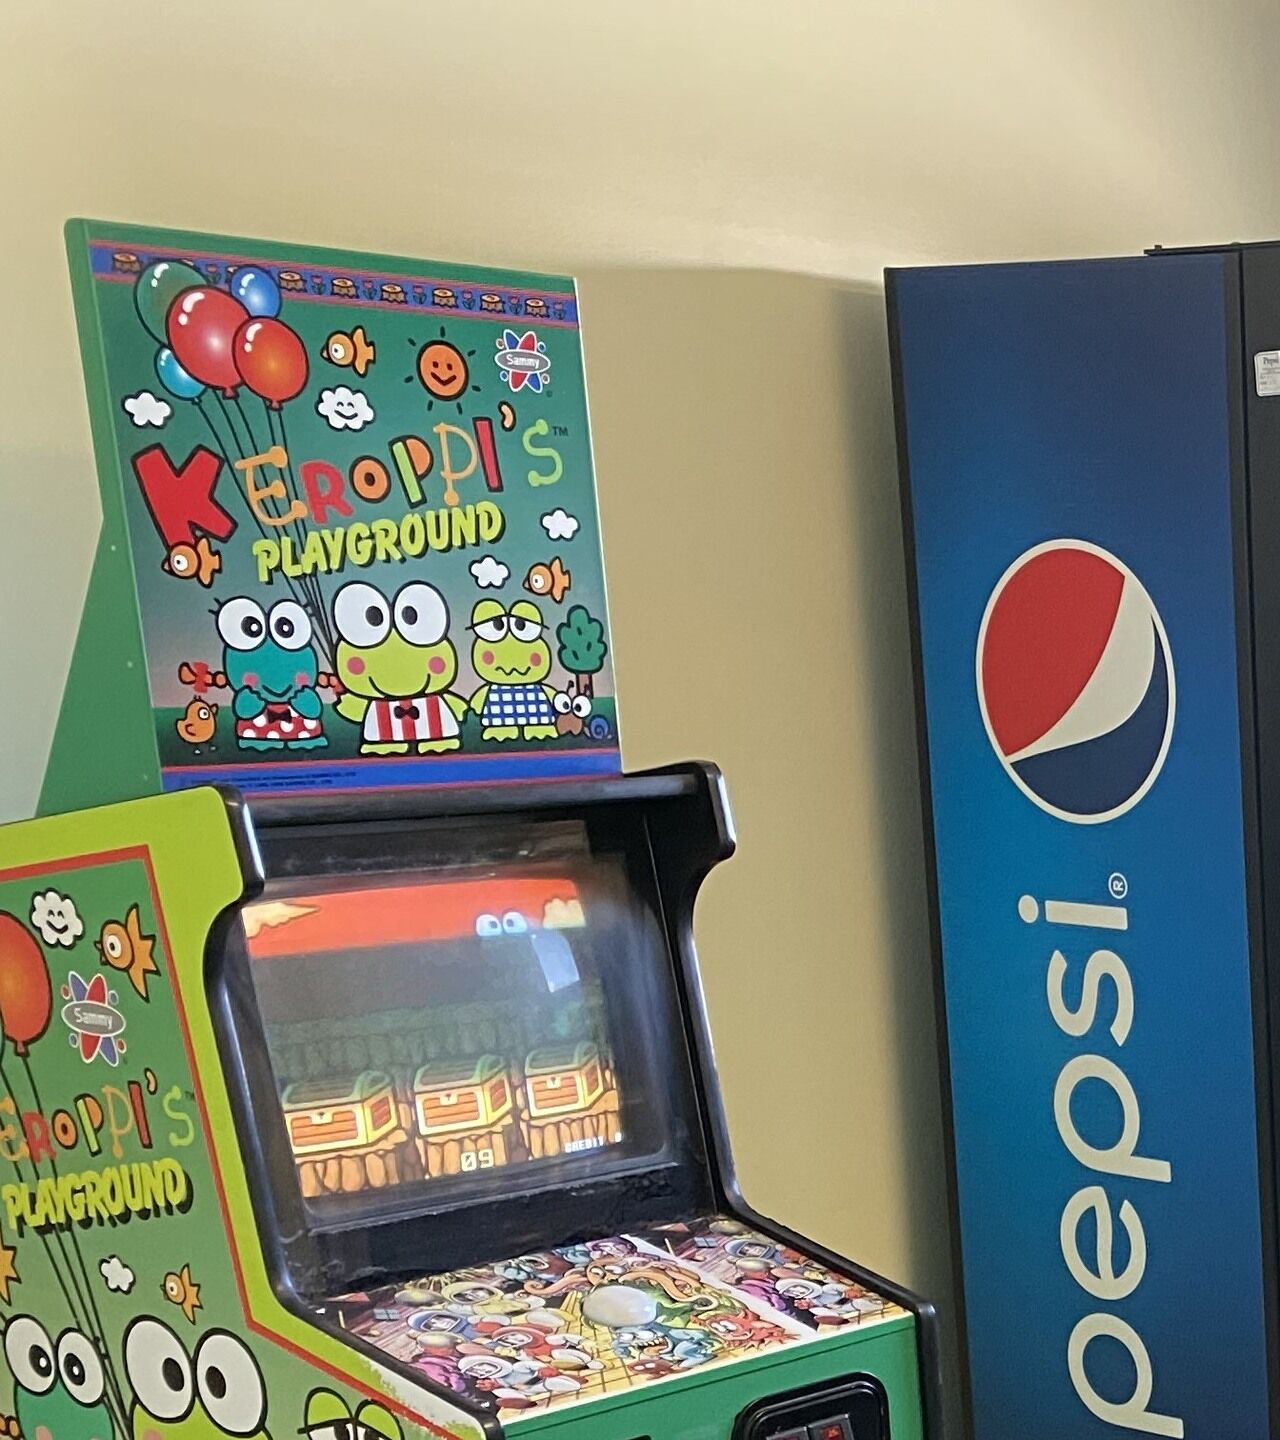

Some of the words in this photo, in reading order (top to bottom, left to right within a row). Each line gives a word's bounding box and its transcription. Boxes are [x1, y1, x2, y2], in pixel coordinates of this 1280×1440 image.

[506, 354, 540, 369] Sammy
[132, 401, 563, 548] KEROPPI'S
[253, 501, 504, 585] PLAYGROUND
[74, 1006, 113, 1030] Sammy
[460, 1149, 494, 1172] 09
[564, 1136, 604, 1153] CREDIT
[1019, 895, 1185, 1440] pepsi
[2, 1158, 192, 1234] PLAYGROUND
